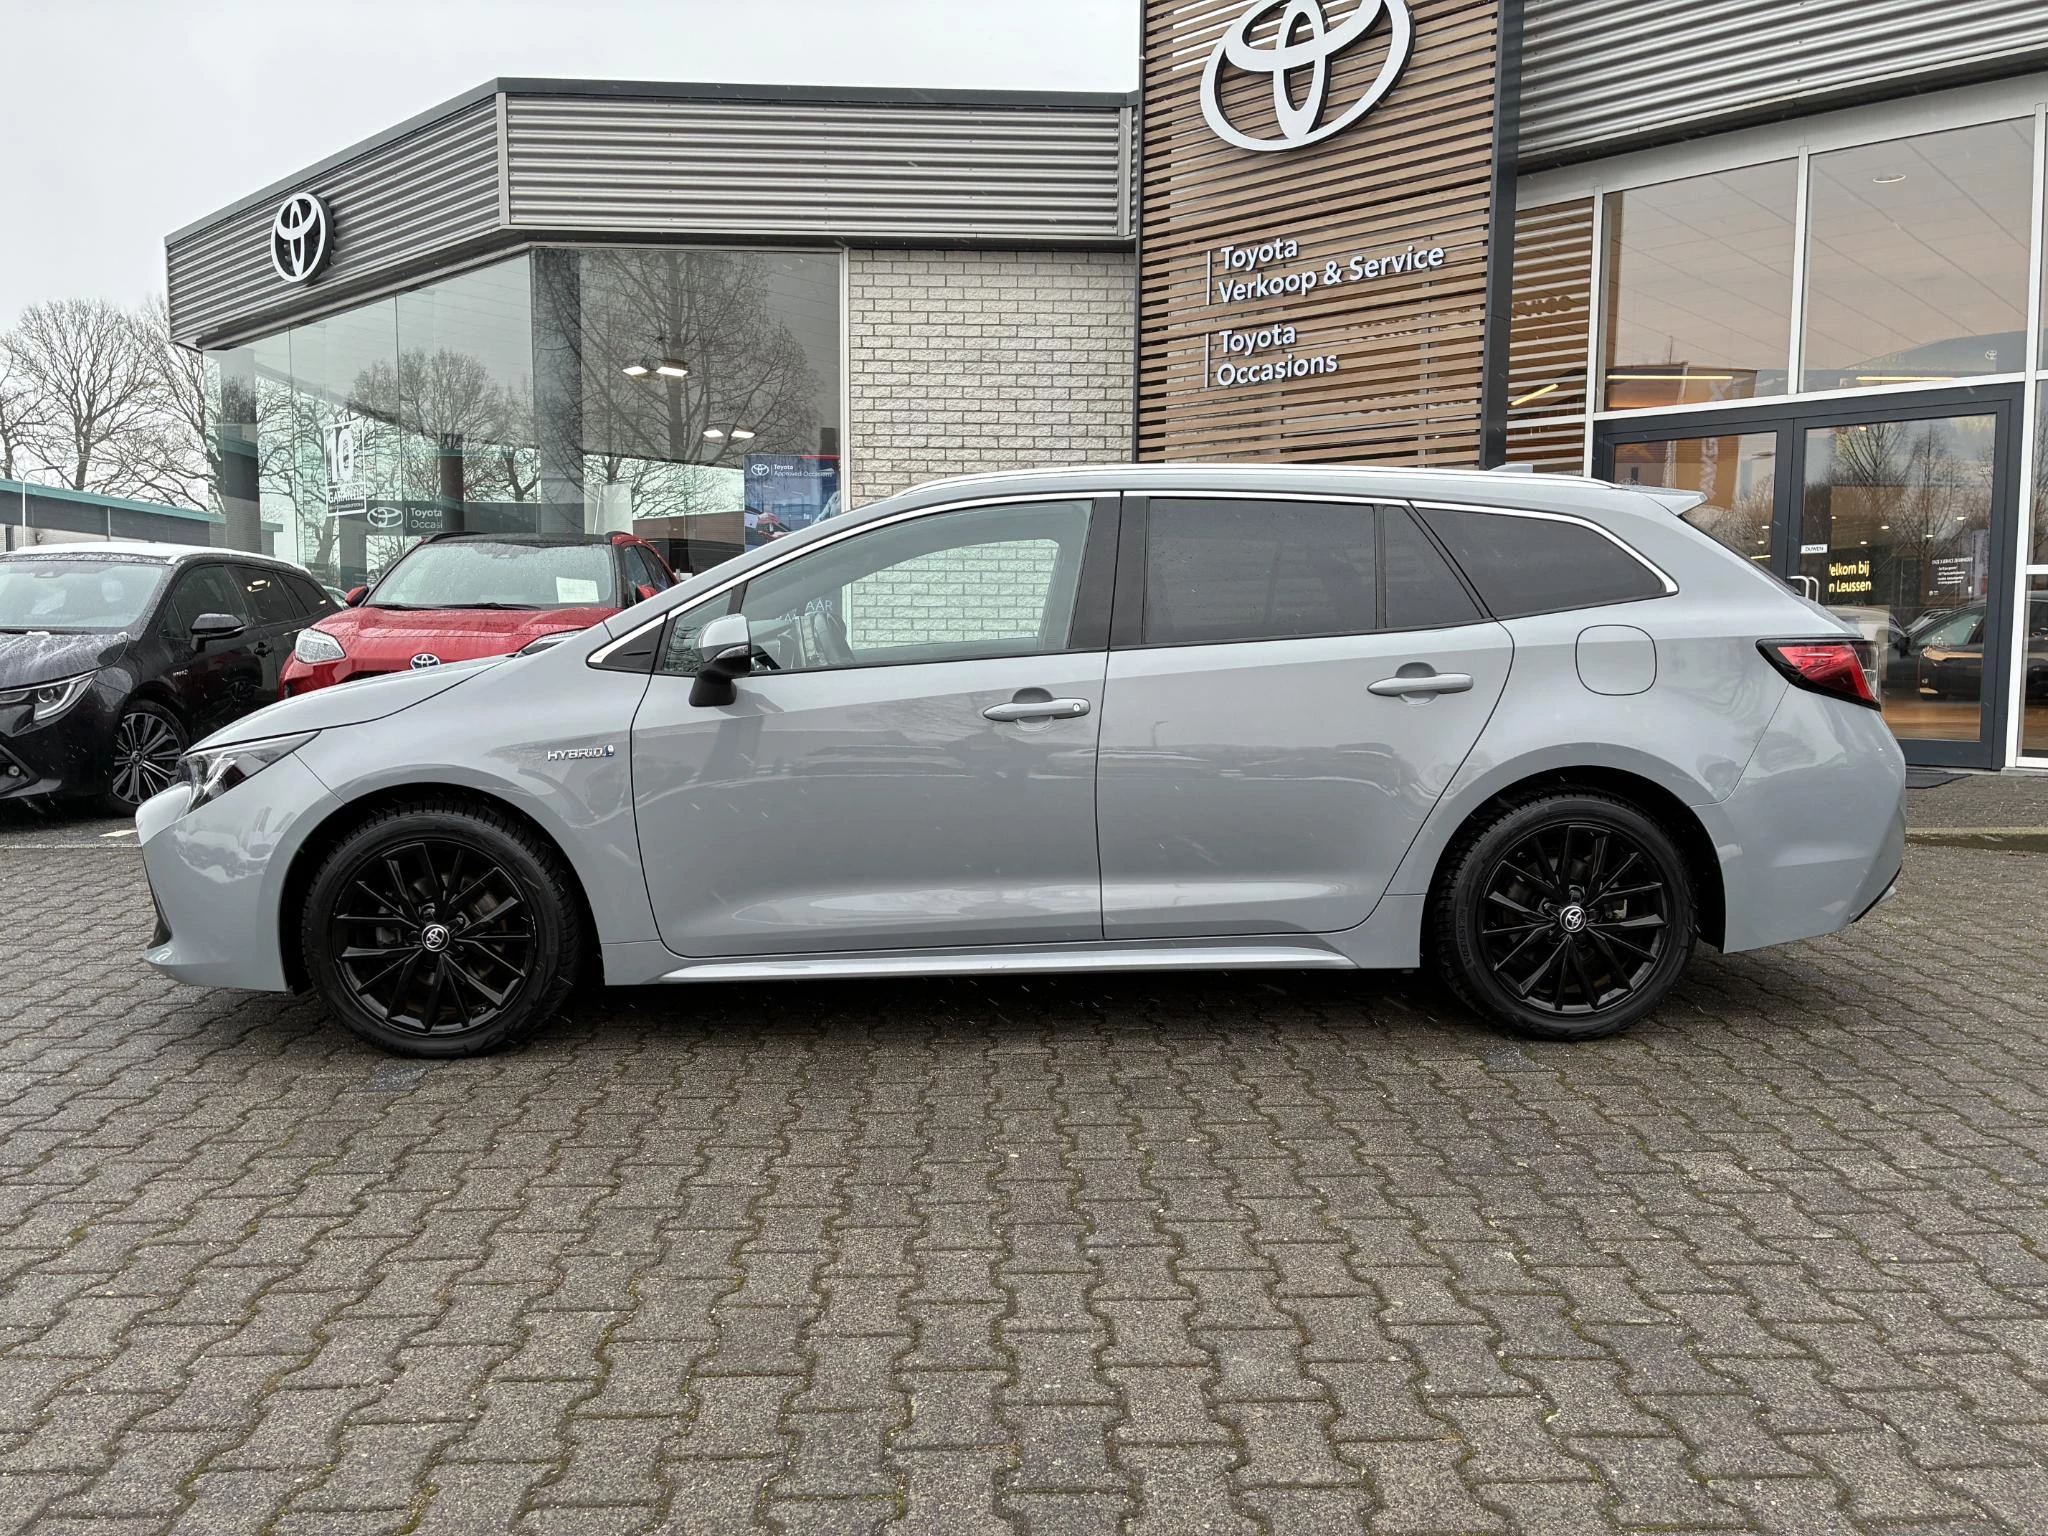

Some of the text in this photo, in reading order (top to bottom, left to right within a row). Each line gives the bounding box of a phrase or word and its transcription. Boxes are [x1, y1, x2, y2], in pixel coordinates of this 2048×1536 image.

[1220, 237, 1299, 271] Toyota
[1218, 245, 1446, 303] Verkoop & Service
[1219, 323, 1297, 356] Toyota
[1216, 354, 1339, 386] Occasions
[410, 507, 443, 519] Toyota
[1829, 560, 1870, 577] elkom bij
[1836, 579, 1872, 593] Leussen
[547, 747, 603, 761] HYBRID
